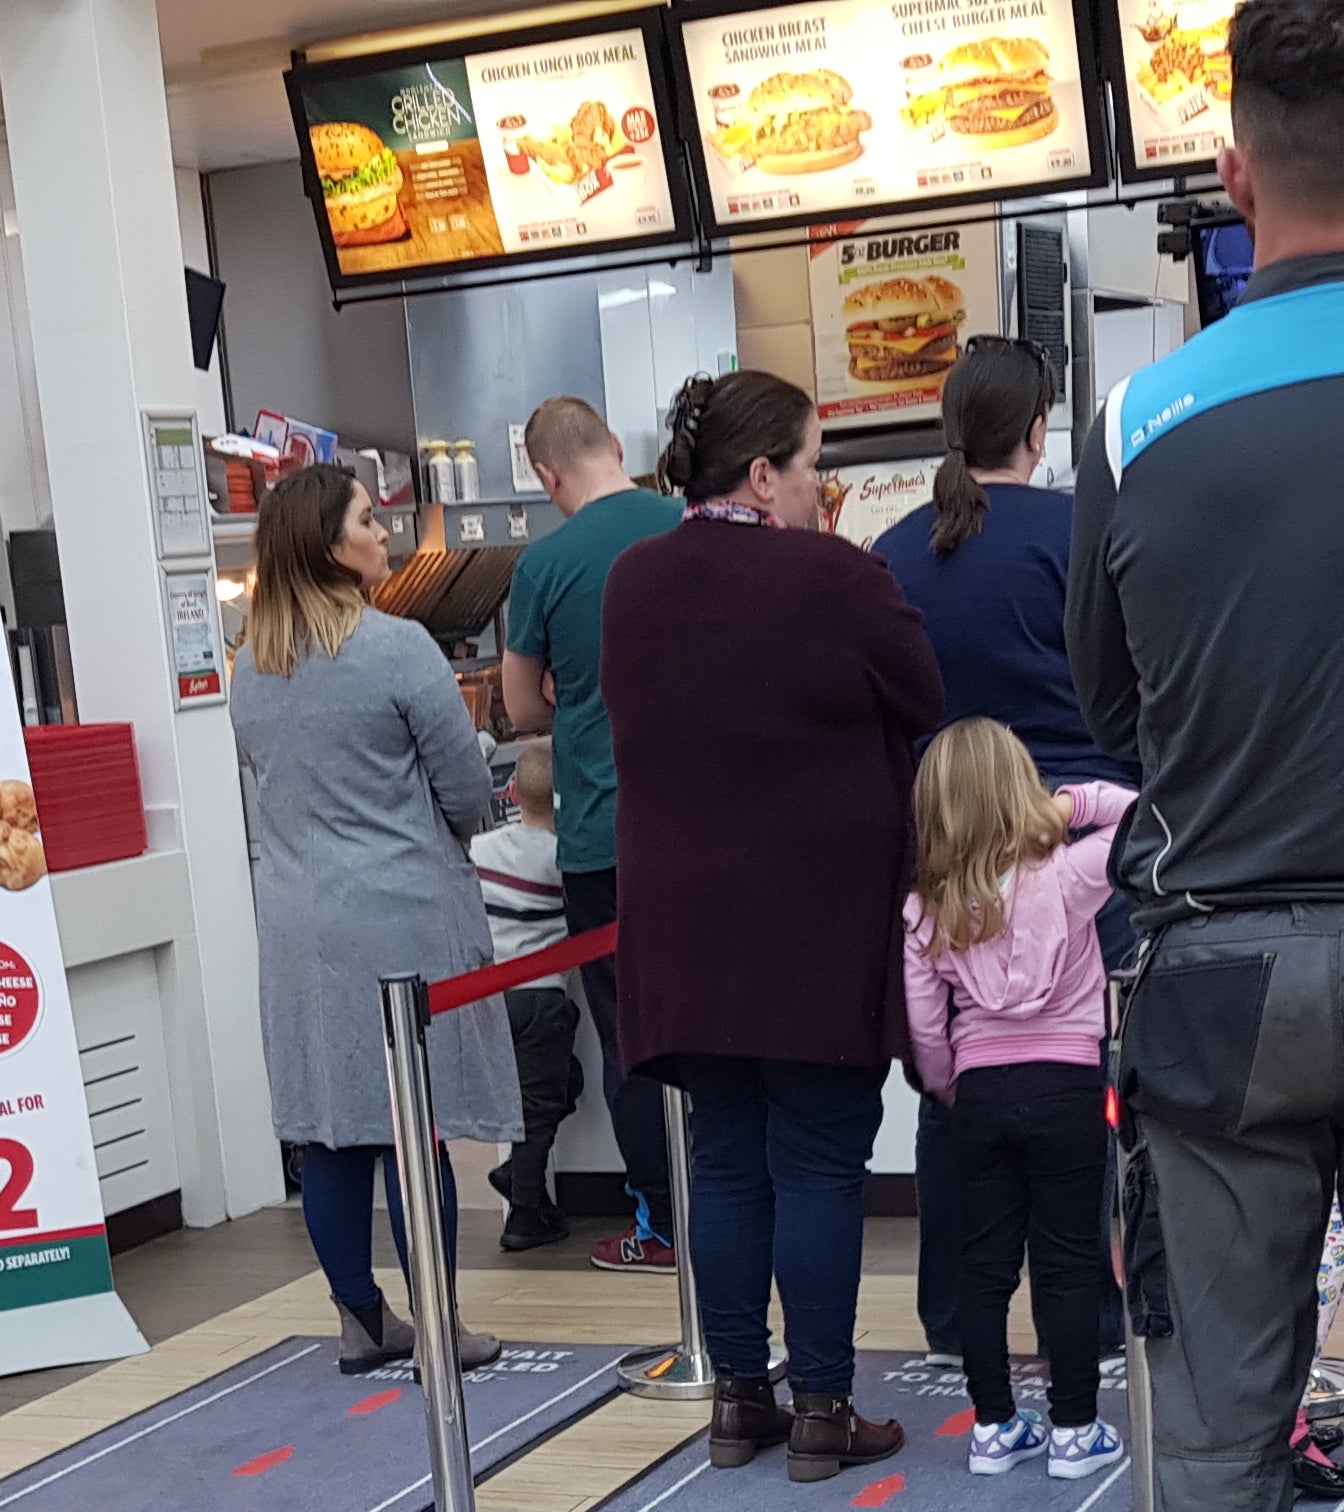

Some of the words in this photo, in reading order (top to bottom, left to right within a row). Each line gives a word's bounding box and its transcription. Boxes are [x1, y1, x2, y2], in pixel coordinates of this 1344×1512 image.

[953, 8, 1005, 28] BURGER
[1010, 2, 1047, 19] MEAL
[722, 25, 775, 47] CHICKEN
[778, 16, 826, 38] BREAST
[725, 42, 791, 64] SANDWICH
[795, 36, 827, 53] MEAL
[481, 62, 531, 84] CHICKEN
[534, 54, 572, 75] LUNCH
[576, 50, 601, 69] BOX
[603, 44, 637, 64] MEAL
[392, 107, 461, 134] CHICKEN
[841, 243, 855, 265] 5
[867, 231, 960, 262] BURGER
[17, 1094, 44, 1113] FOR
[6, 1246, 71, 1270] SEPARATELY!
[882, 1371, 929, 1383] TO
[938, 1374, 969, 1384] B
[916, 1384, 970, 1397] THA
